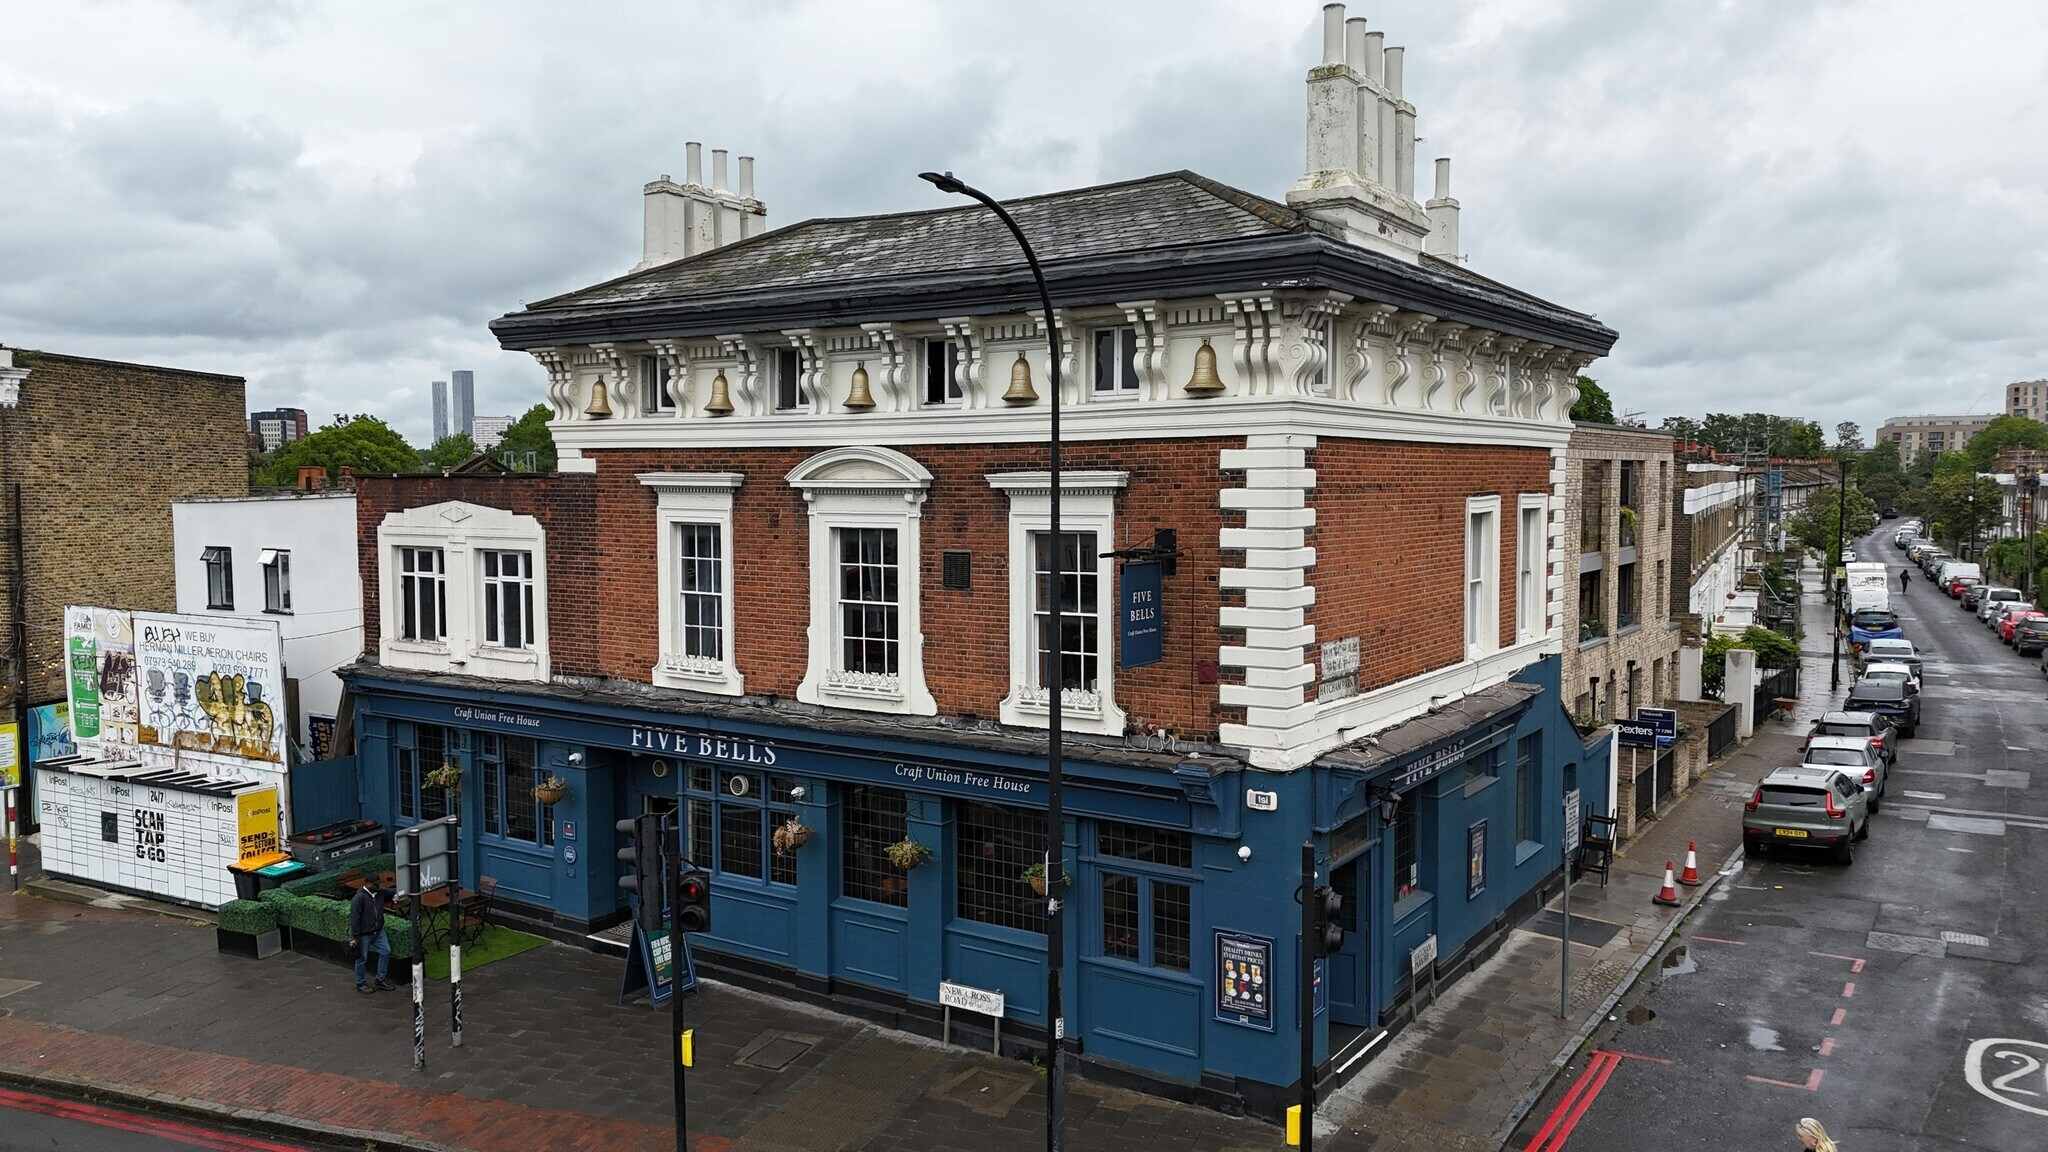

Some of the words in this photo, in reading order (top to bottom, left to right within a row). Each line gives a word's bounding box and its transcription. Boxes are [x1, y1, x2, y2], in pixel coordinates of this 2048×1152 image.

[1132, 590, 1152, 603] FIVE
[1130, 608, 1154, 621] BELLS
[185, 630, 198, 641] WE
[200, 631, 216, 643] BUY
[139, 641, 173, 654] HERMAN
[175, 644, 204, 657] MILLER
[235, 649, 268, 663] CHAIRS
[144, 656, 166, 667] 07973
[454, 706, 472, 719] Craft
[474, 709, 496, 721] Union
[498, 712, 514, 724] Free
[516, 714, 540, 728] House
[1618, 724, 1653, 736] Dexters
[631, 725, 688, 753] FIVE
[699, 734, 776, 765] BELLS
[49, 775, 67, 787] InPost
[895, 763, 923, 780] Craft
[927, 767, 961, 785] Union
[964, 772, 990, 788] Free
[993, 776, 1030, 793] House
[110, 785, 130, 798] InPost
[150, 790, 164, 804] 24/7
[211, 801, 233, 814] InPost
[135, 809, 164, 832] SCAN
[135, 828, 165, 847] TAP
[241, 831, 268, 844] SEND
[136, 844, 146, 859] &
[147, 847, 166, 863] GO
[1223, 946, 1243, 956] QUALITY
[1223, 952, 1246, 961] EVERYDAY
[1247, 956, 1264, 965] PRICES
[944, 985, 961, 996] NEW
[944, 994, 968, 1006] ROAD
